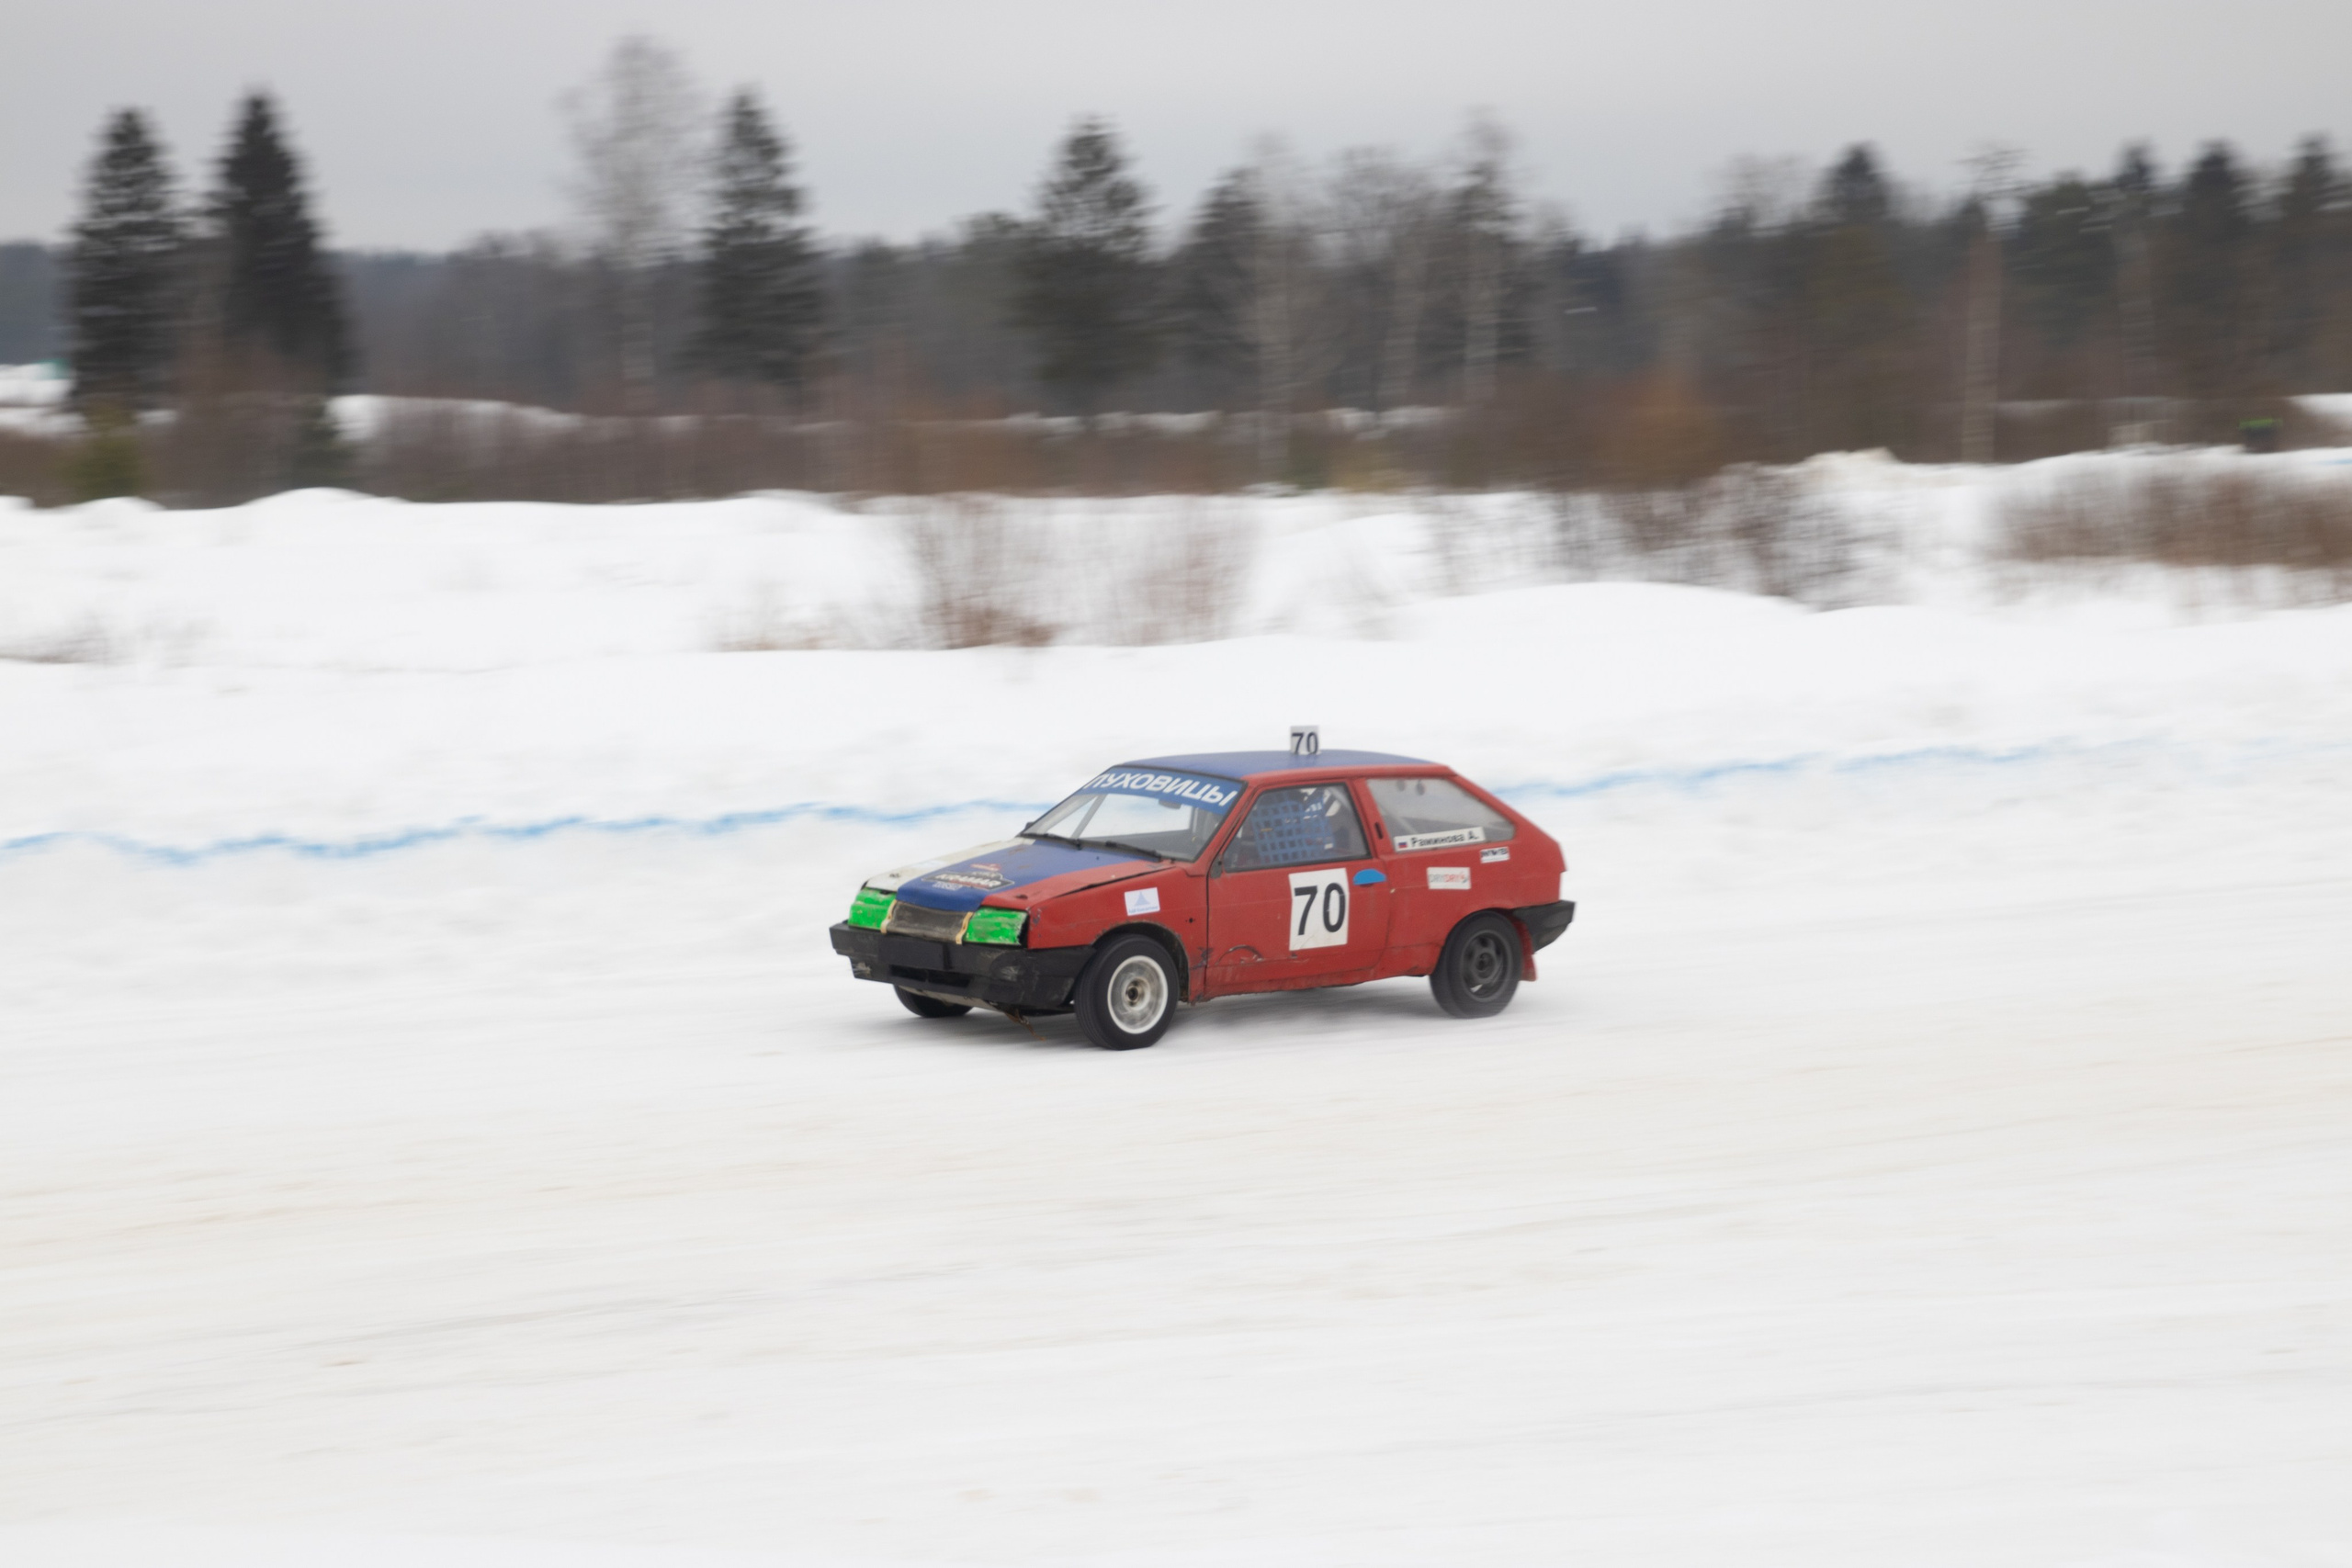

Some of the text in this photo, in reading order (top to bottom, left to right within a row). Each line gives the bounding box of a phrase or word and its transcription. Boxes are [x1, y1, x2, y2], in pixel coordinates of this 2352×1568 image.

[1291, 731, 1318, 755] 70
[1082, 773, 1238, 807] ЛУХОВИЦЫ
[1294, 882, 1346, 936] 70
